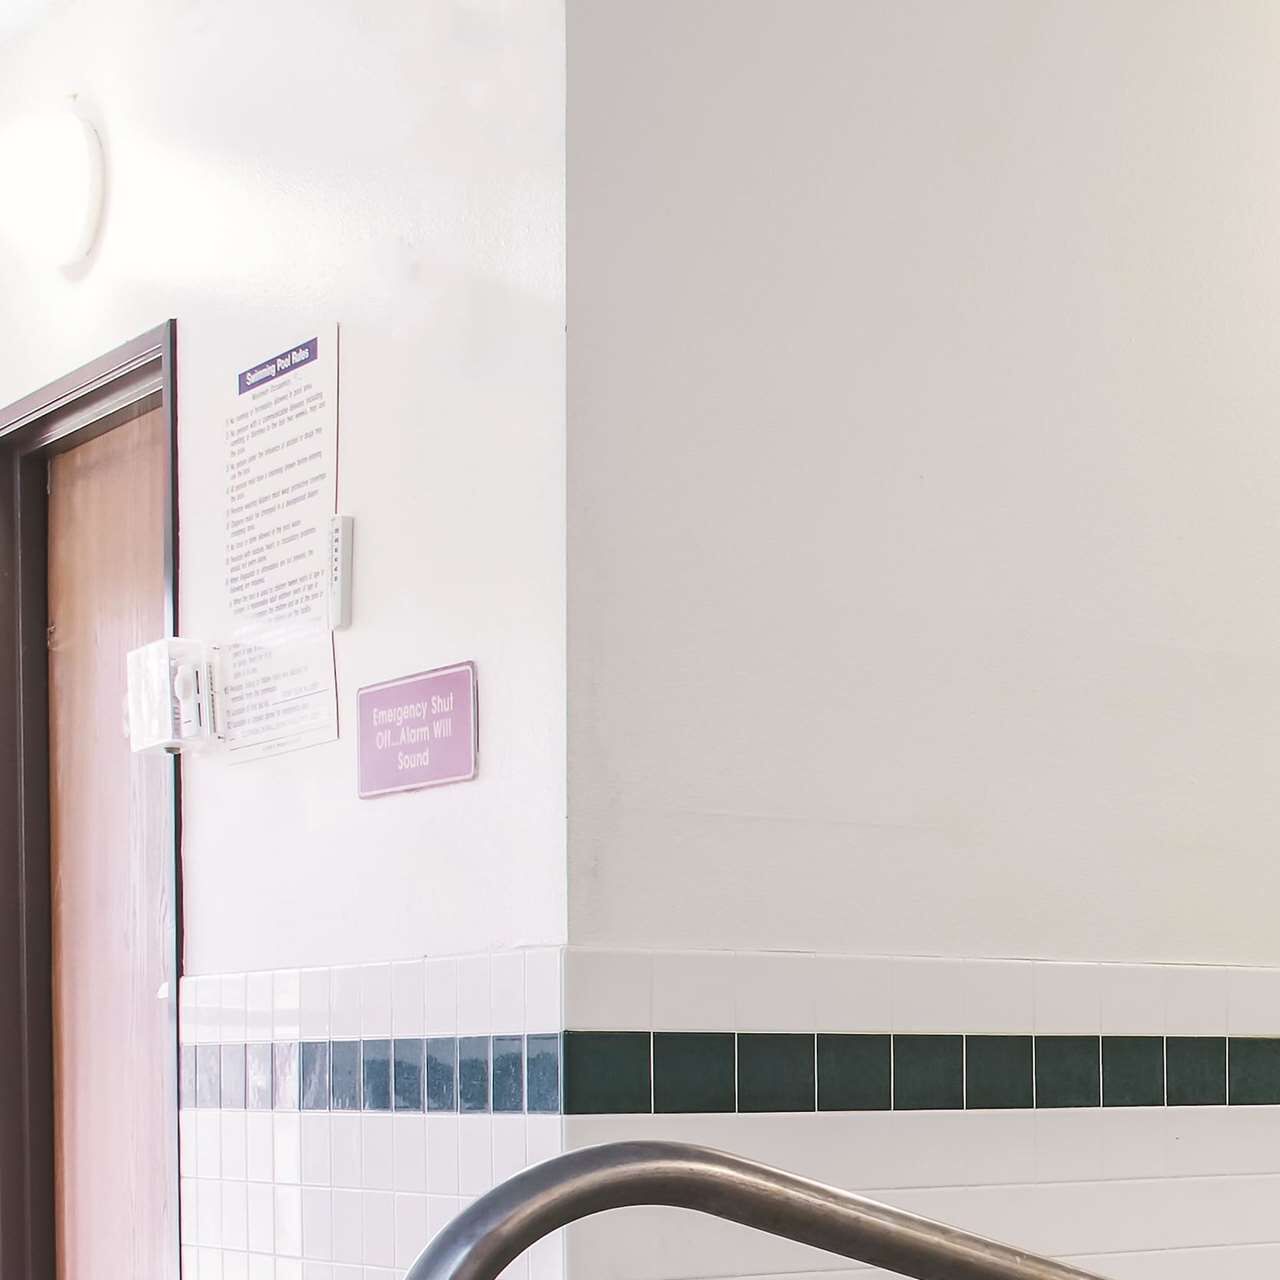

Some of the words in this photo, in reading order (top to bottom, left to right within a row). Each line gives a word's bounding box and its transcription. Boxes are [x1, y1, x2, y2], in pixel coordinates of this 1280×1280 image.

[276, 353, 291, 372] Pool
[373, 701, 427, 726] Emergency
[431, 691, 454, 715] Shut
[433, 718, 452, 738] Will
[398, 747, 430, 770] Sound
